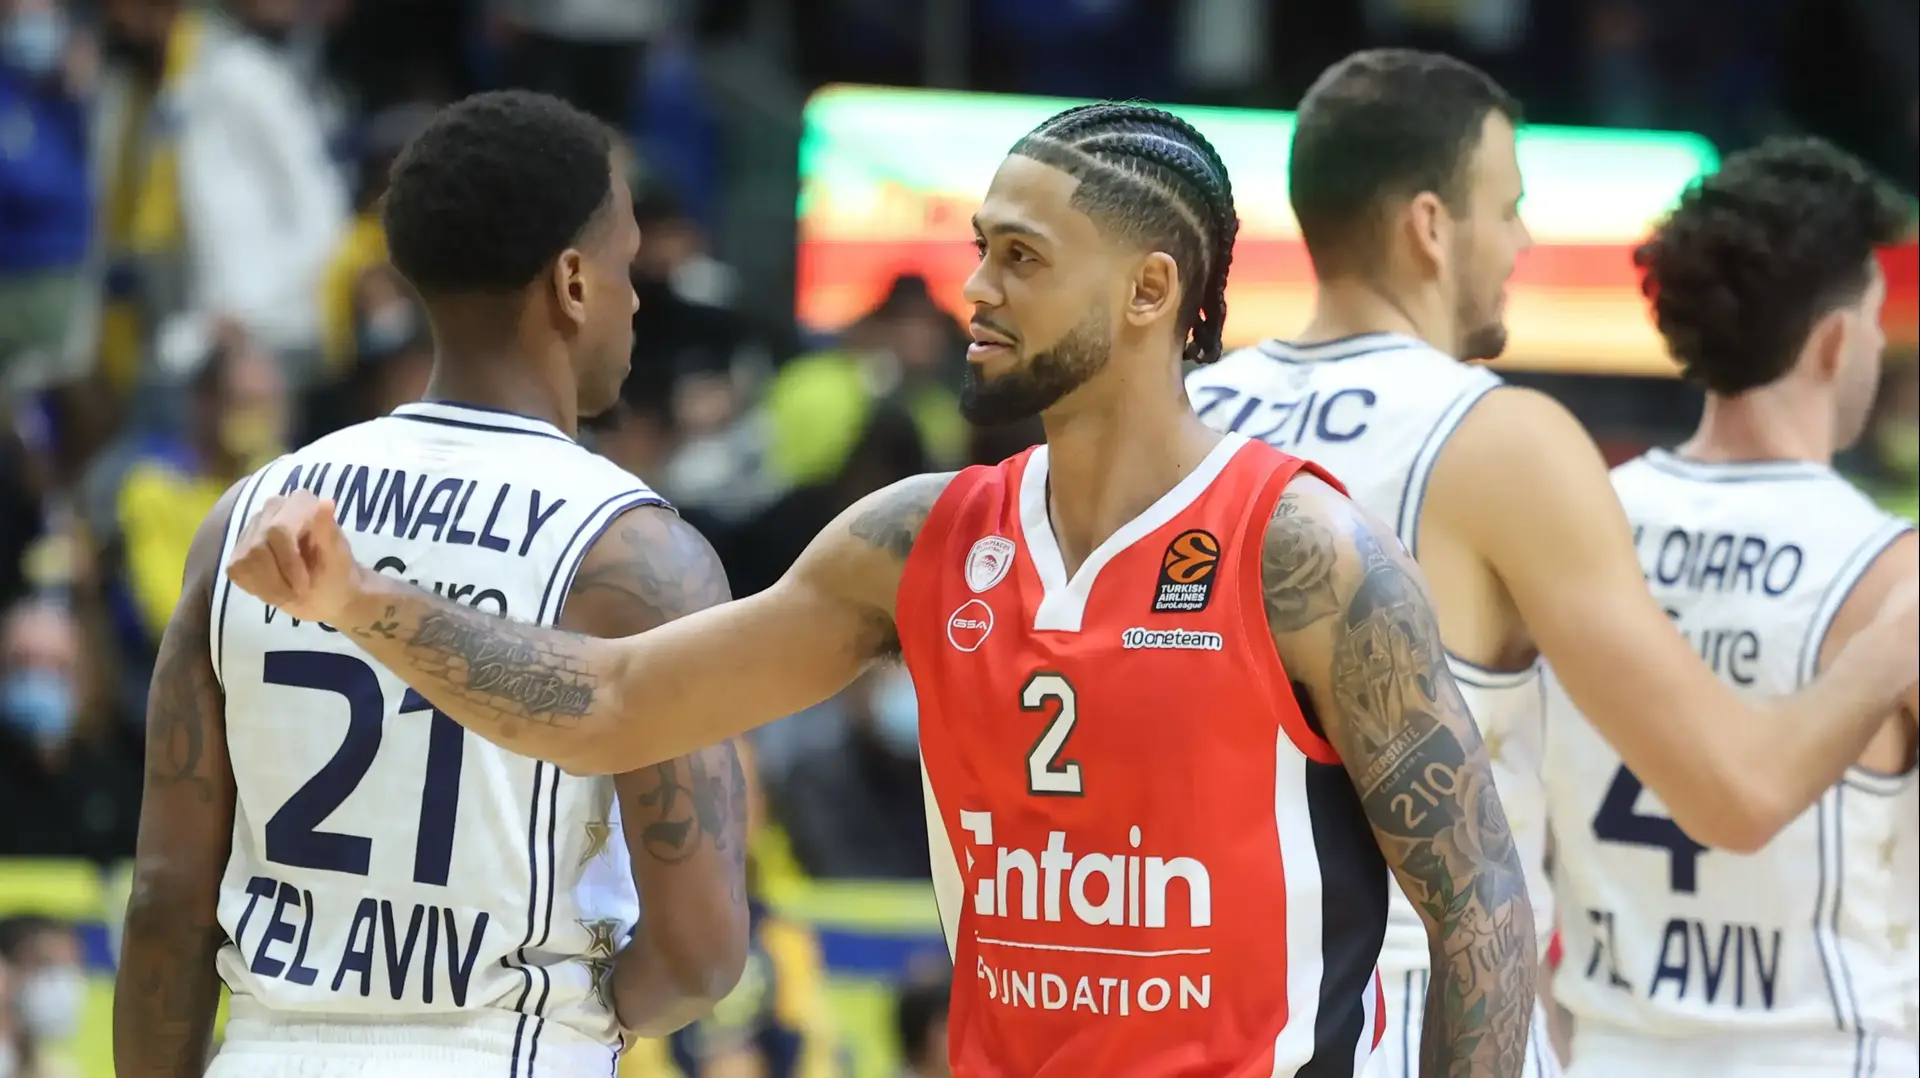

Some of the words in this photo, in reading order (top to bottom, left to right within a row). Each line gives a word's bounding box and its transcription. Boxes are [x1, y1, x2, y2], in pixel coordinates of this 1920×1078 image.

[1155, 601, 1203, 611] EuroLeague
[1158, 593, 1205, 602] AIRLINES
[1160, 584, 1207, 594] TURKISH
[952, 618, 988, 630] GSA
[1122, 628, 1222, 650] 10oneteam
[1019, 671, 1085, 797] 2
[263, 649, 465, 887] 21
[1390, 762, 1457, 830] 210
[235, 876, 319, 987] TEL
[331, 897, 490, 1008] AVIV
[1650, 917, 1781, 1011] AVIV
